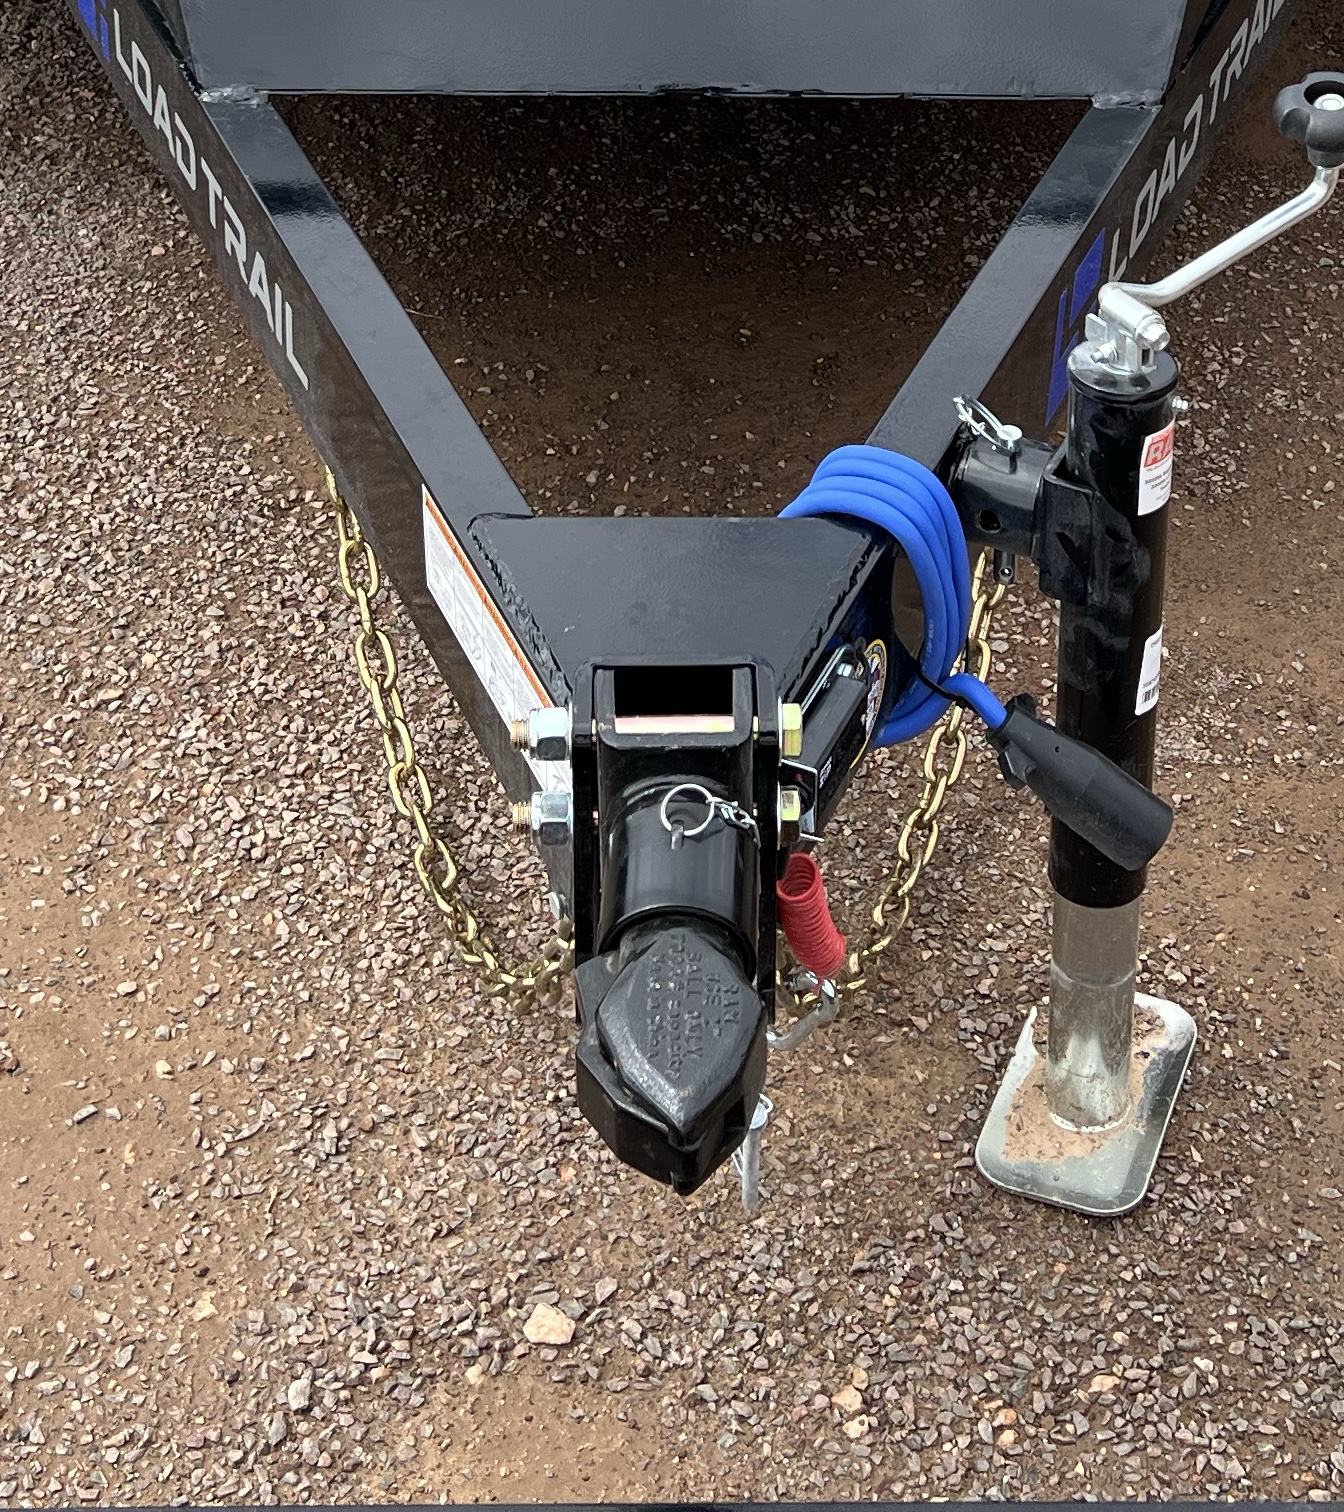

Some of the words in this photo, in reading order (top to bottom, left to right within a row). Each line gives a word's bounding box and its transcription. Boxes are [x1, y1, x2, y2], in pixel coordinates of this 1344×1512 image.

[113, 7, 197, 191] LOAD
[200, 156, 309, 391] TRAIL
[1108, 94, 1204, 284] LOAD
